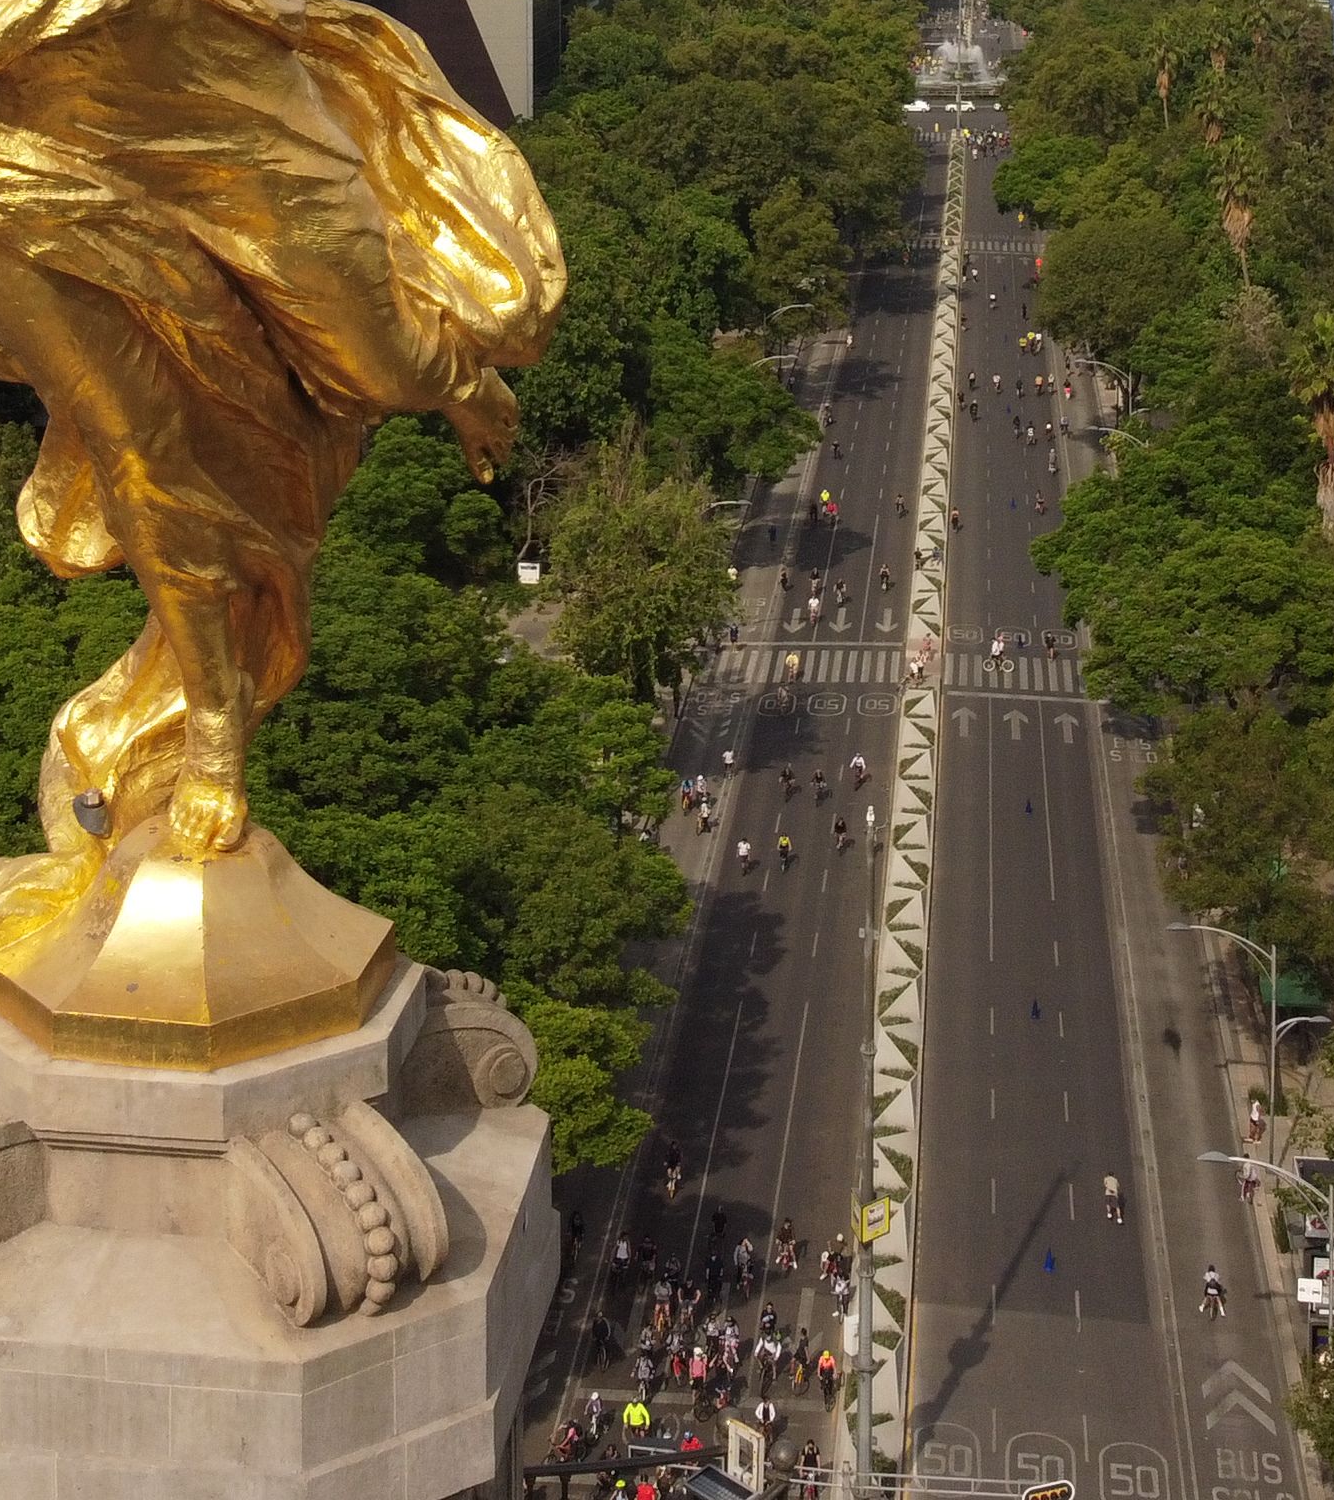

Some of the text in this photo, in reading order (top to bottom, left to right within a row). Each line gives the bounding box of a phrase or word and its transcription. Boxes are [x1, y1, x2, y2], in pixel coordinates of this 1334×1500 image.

[923, 1441, 972, 1476] 50
[1018, 1453, 1065, 1485] 50
[1217, 1448, 1283, 1484] BUS
[1110, 1463, 1160, 1498] 50
